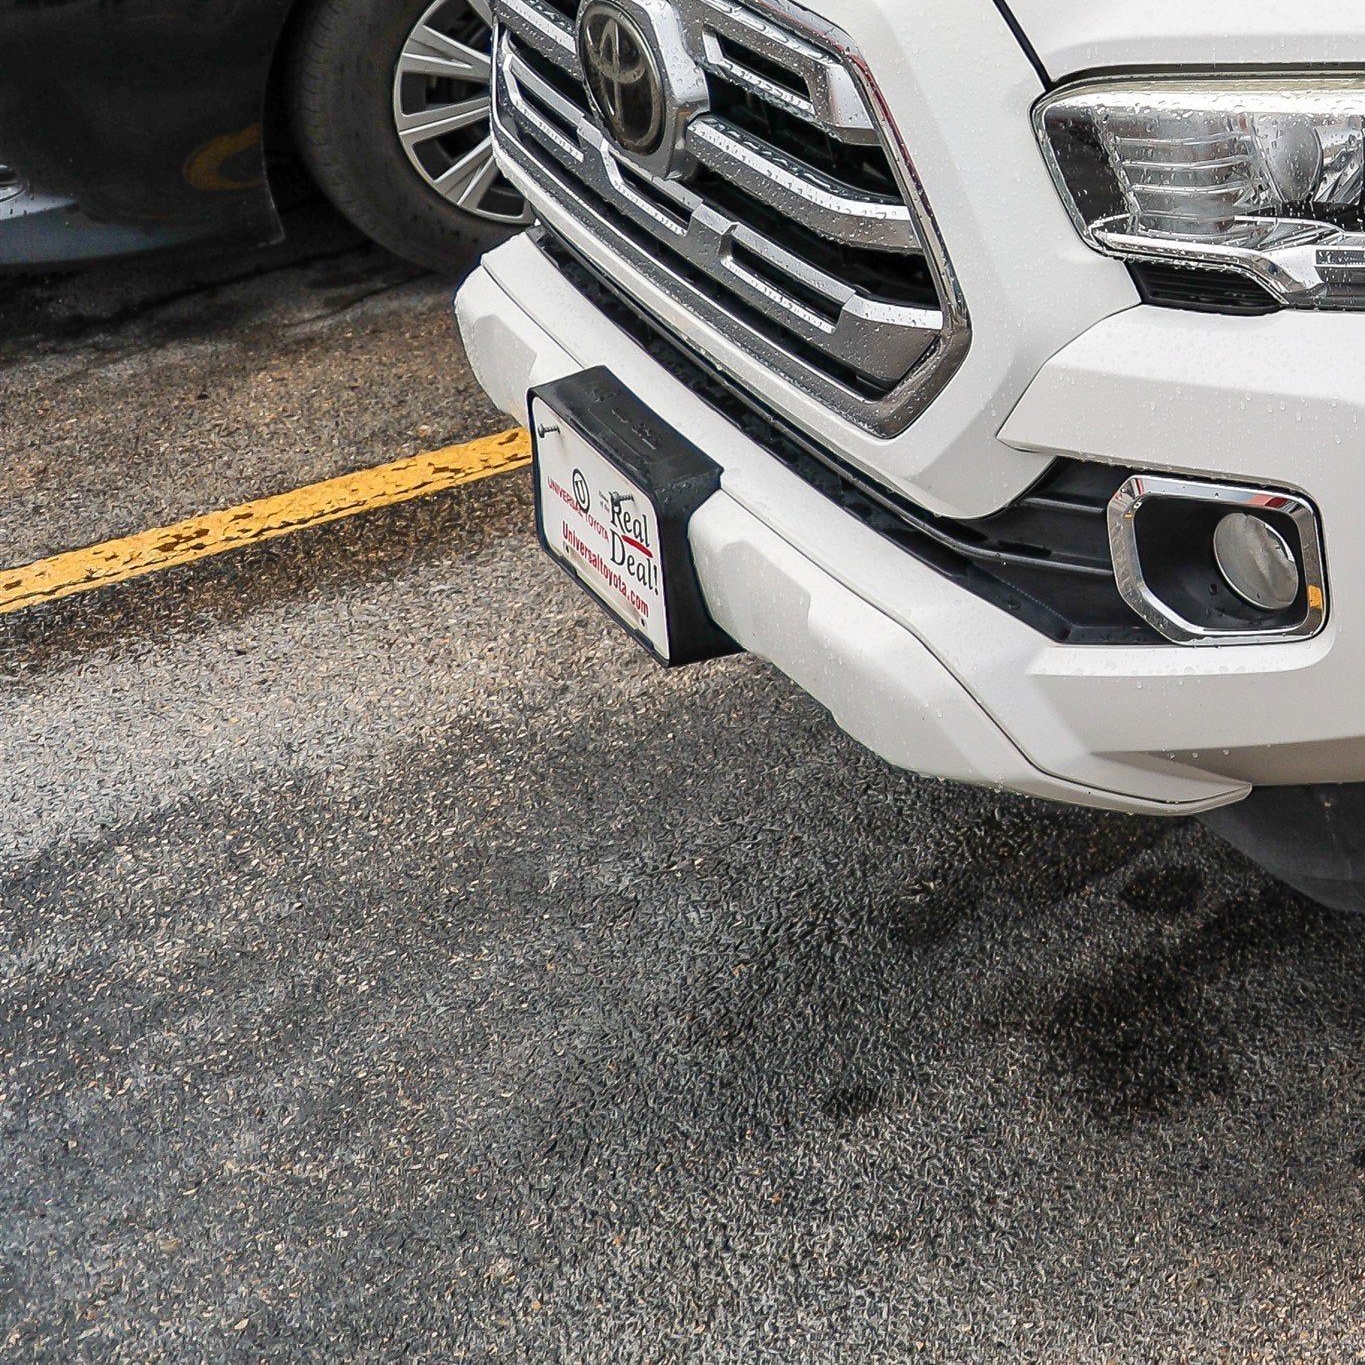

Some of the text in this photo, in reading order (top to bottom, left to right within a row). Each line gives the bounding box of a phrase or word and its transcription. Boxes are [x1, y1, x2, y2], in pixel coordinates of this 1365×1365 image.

[609, 491, 651, 548] Real
[562, 520, 649, 618] Universaltoyota.com
[609, 527, 659, 596] Deal!
